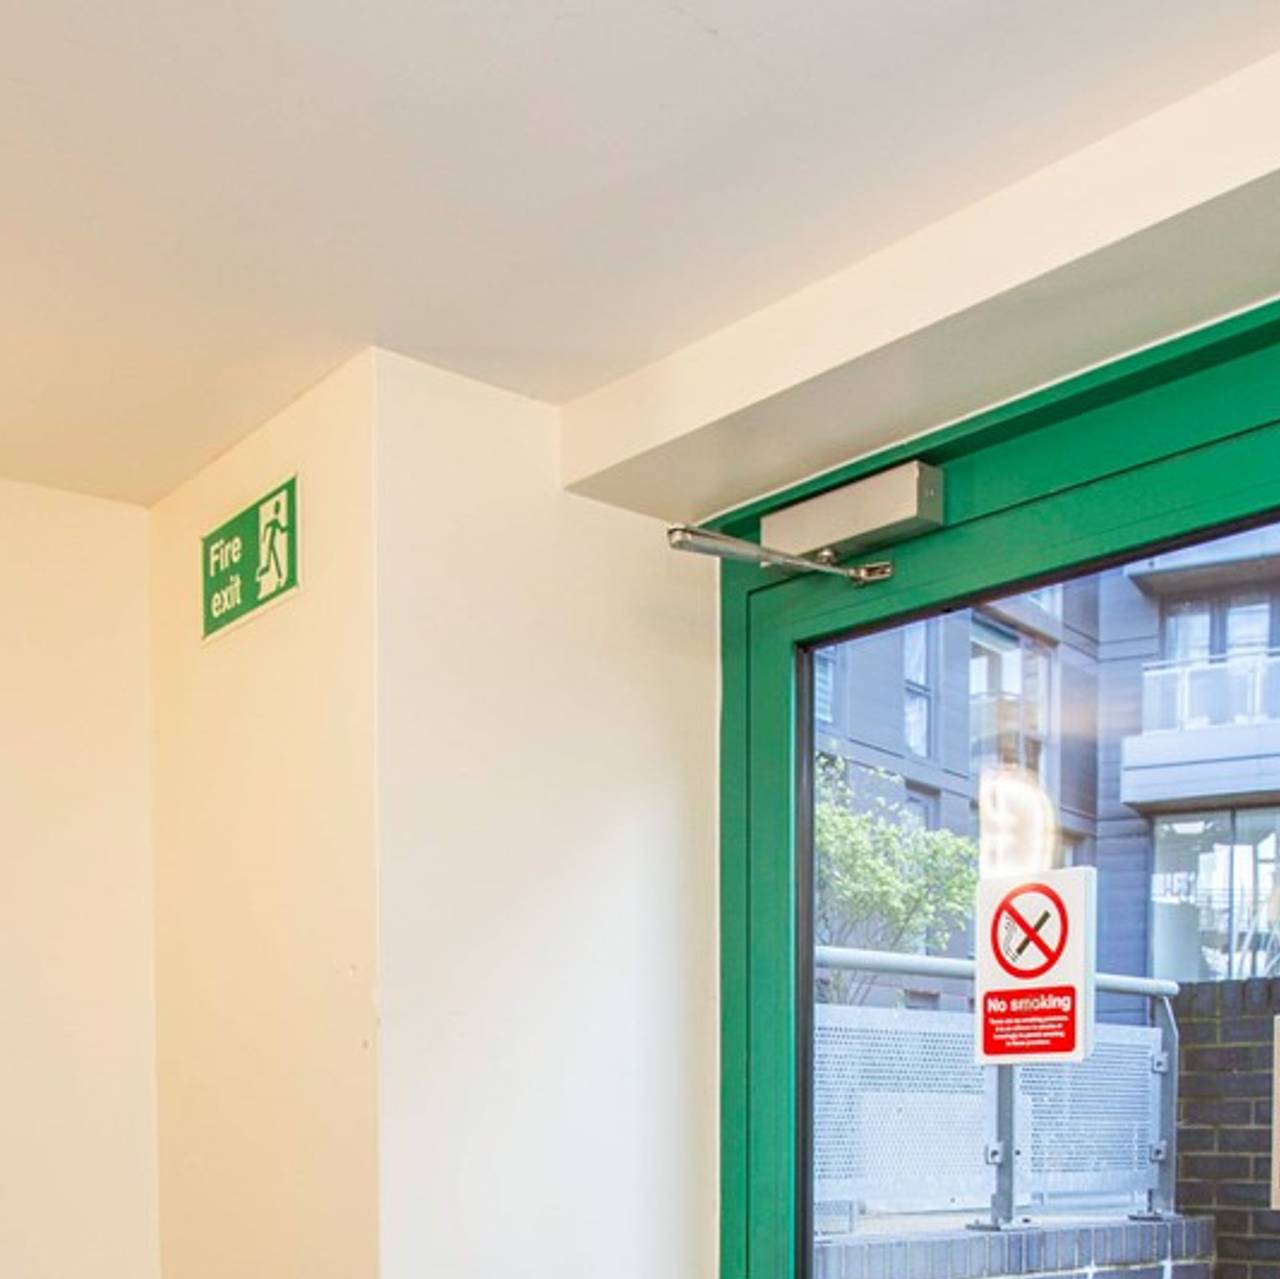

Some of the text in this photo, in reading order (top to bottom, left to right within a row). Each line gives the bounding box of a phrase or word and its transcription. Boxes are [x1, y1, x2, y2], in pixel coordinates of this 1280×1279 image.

[209, 536, 242, 577] Fire
[211, 574, 242, 618] exit
[987, 993, 1072, 1013] No smoking
